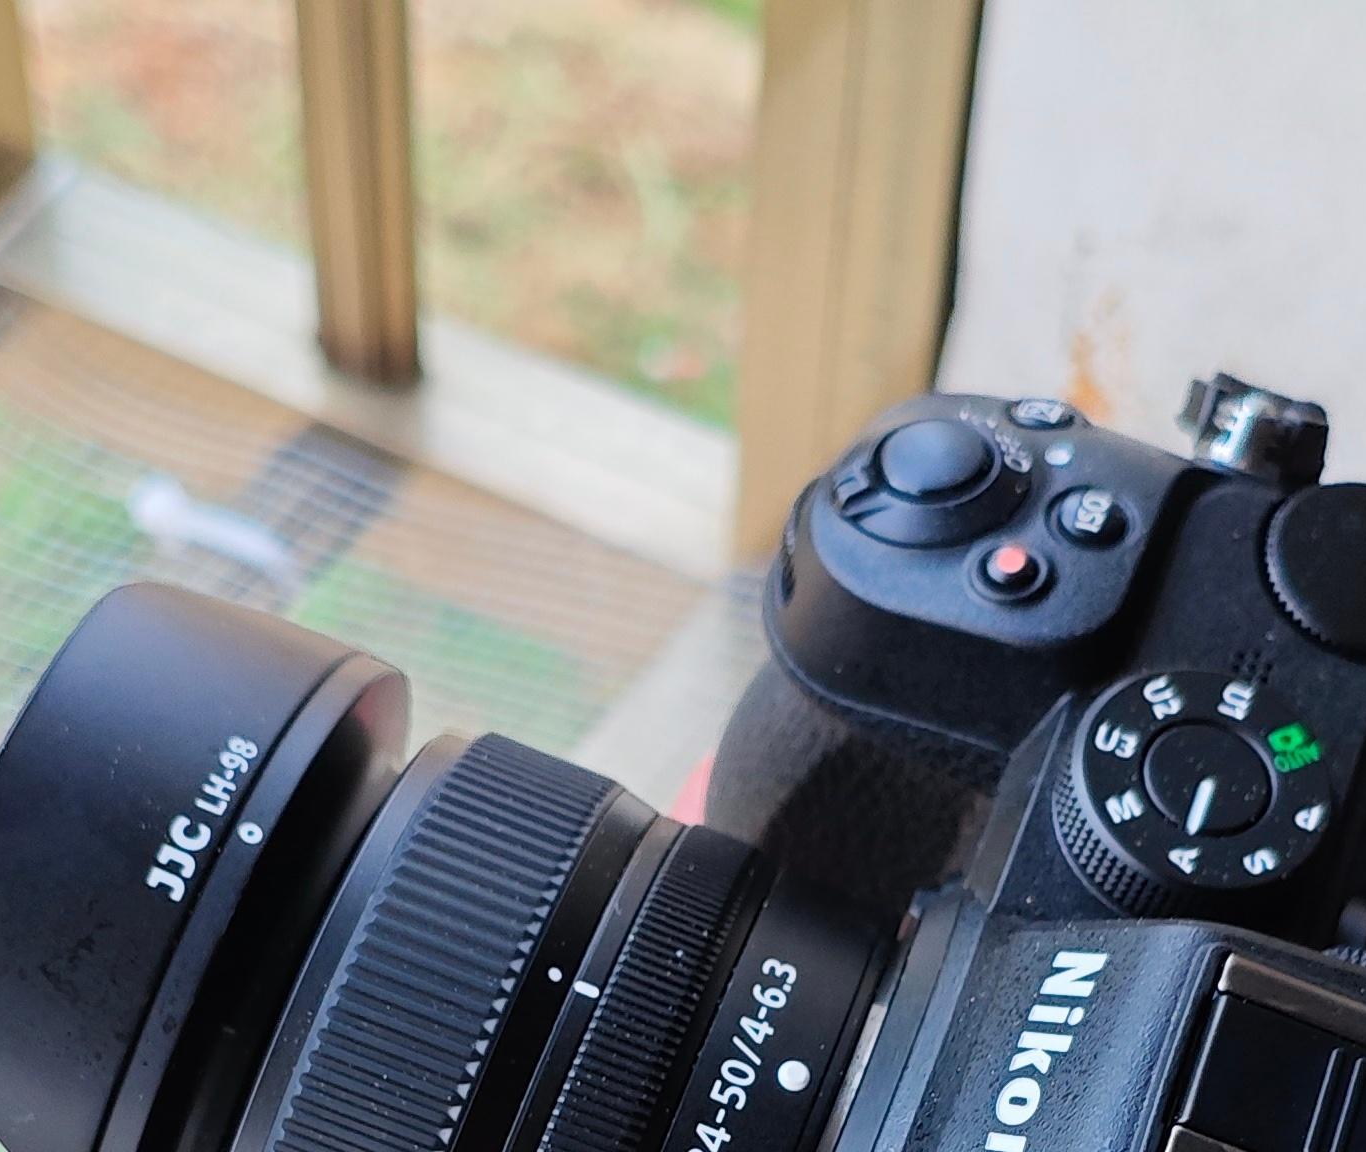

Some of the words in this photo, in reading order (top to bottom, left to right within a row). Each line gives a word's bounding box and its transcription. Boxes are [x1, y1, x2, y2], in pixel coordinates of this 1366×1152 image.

[1074, 489, 1113, 533] ISO
[1143, 674, 1184, 720] U2
[1217, 679, 1256, 721] U1
[1094, 719, 1138, 759] U3
[146, 814, 212, 902] JJC
[194, 735, 259, 816] LH-98
[1105, 789, 1144, 824] M
[1294, 805, 1323, 832] P
[1167, 847, 1201, 875] A
[1242, 848, 1276, 875] S
